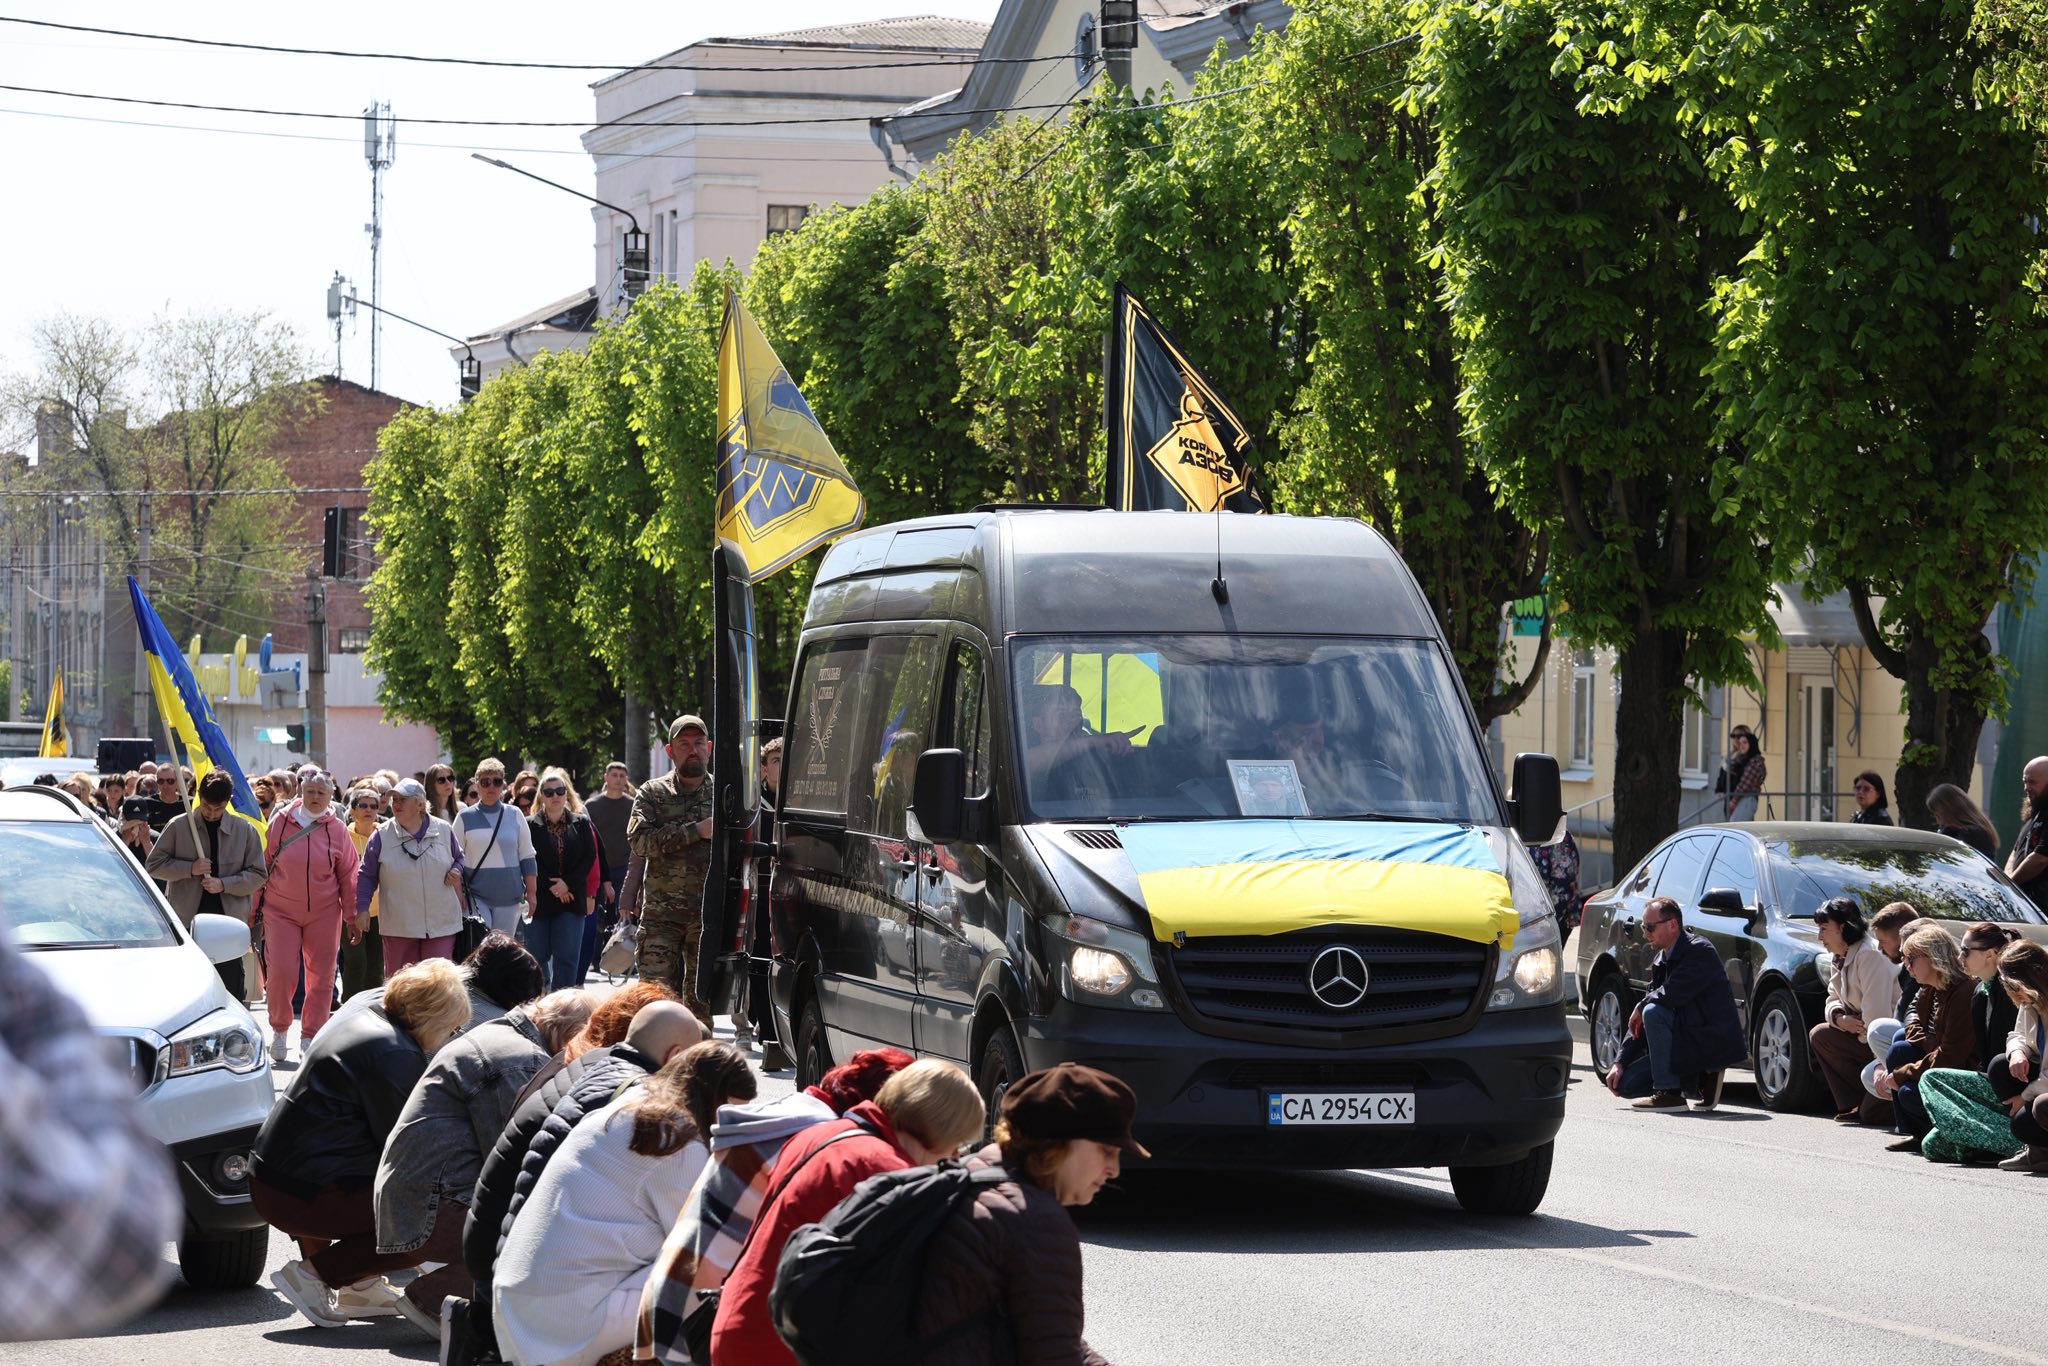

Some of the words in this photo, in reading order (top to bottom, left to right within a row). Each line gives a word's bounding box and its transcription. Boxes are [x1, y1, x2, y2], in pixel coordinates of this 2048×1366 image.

[1178, 449, 1234, 484] АЗОВ
[1270, 1112, 1281, 1121] UA
[1283, 1098, 1315, 1121] CA
[1321, 1098, 1372, 1120] 2954
[1377, 1097, 1408, 1120] CX
